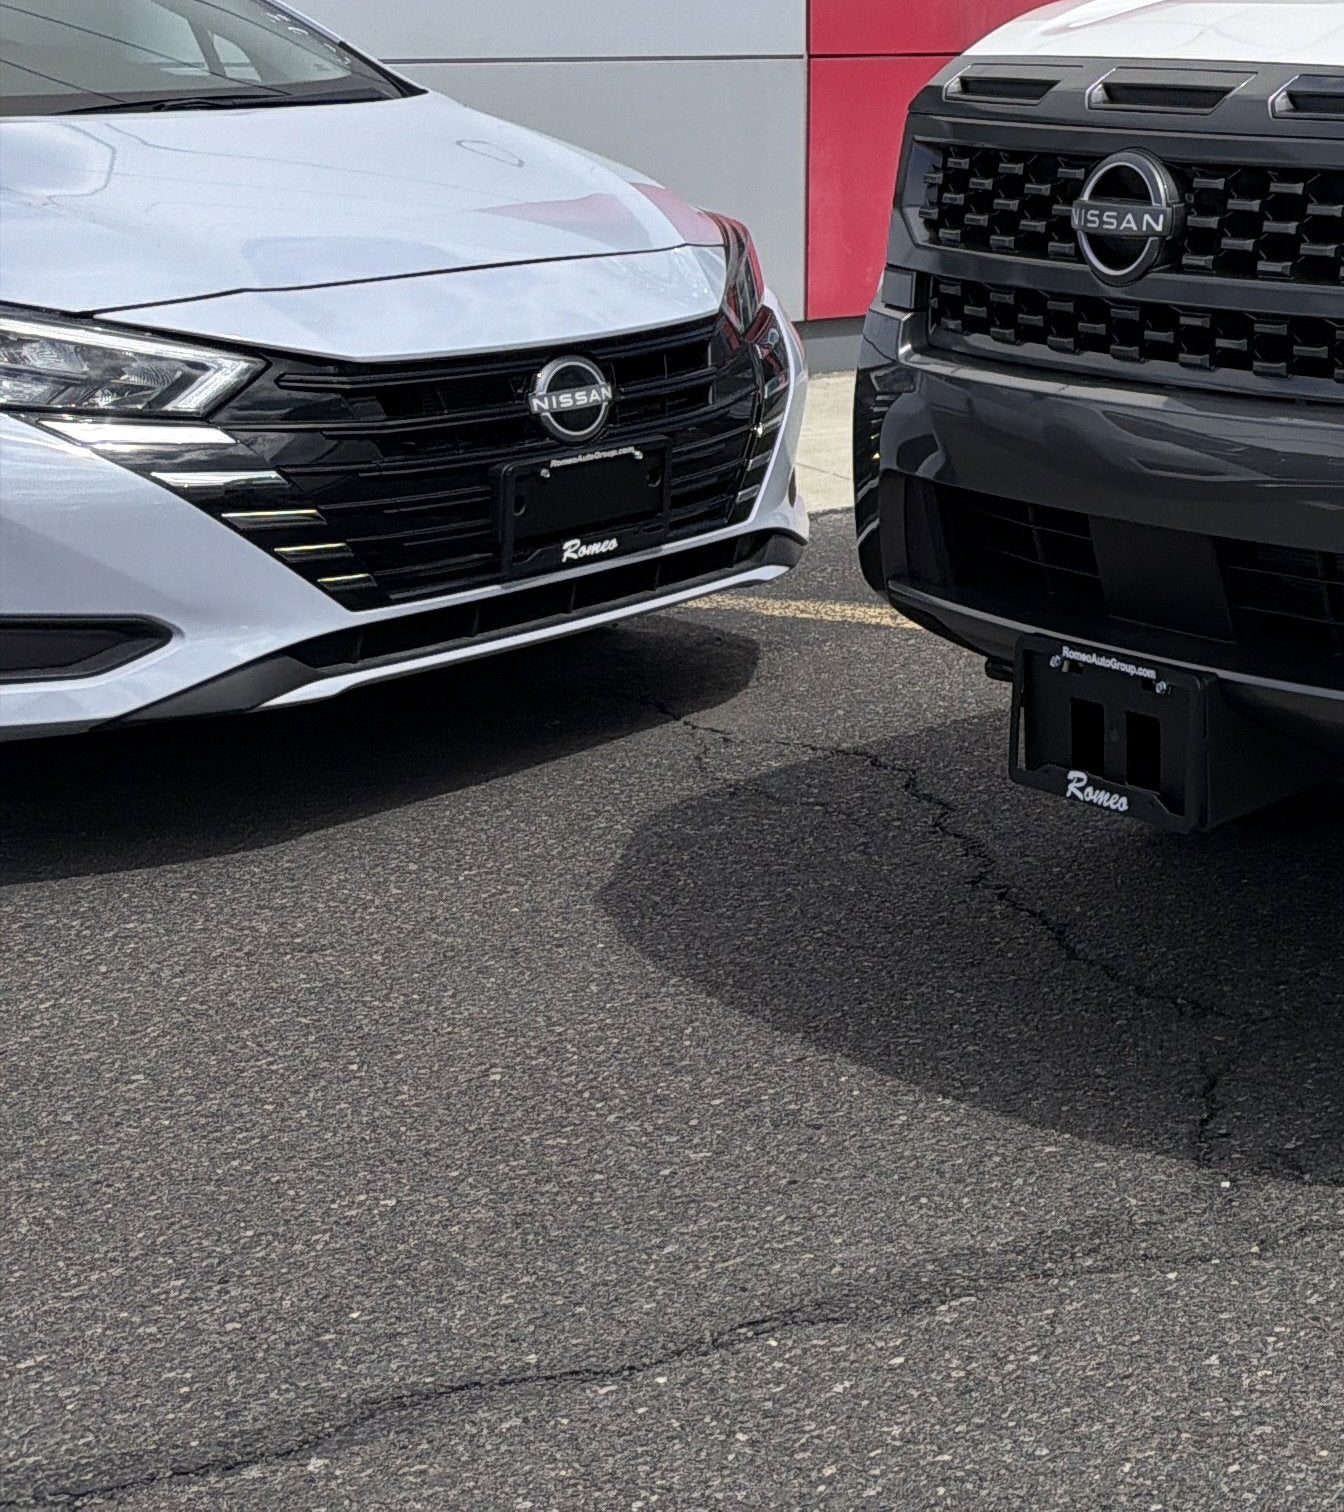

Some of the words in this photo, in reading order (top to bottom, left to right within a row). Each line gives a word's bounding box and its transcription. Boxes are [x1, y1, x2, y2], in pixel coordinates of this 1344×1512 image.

[1072, 208, 1164, 232] NISSAN
[532, 386, 612, 412] NISSAN
[562, 538, 618, 563] Romeo
[1062, 646, 1156, 679] RomeoAutoGroup.com
[1066, 770, 1128, 812] Romeo
